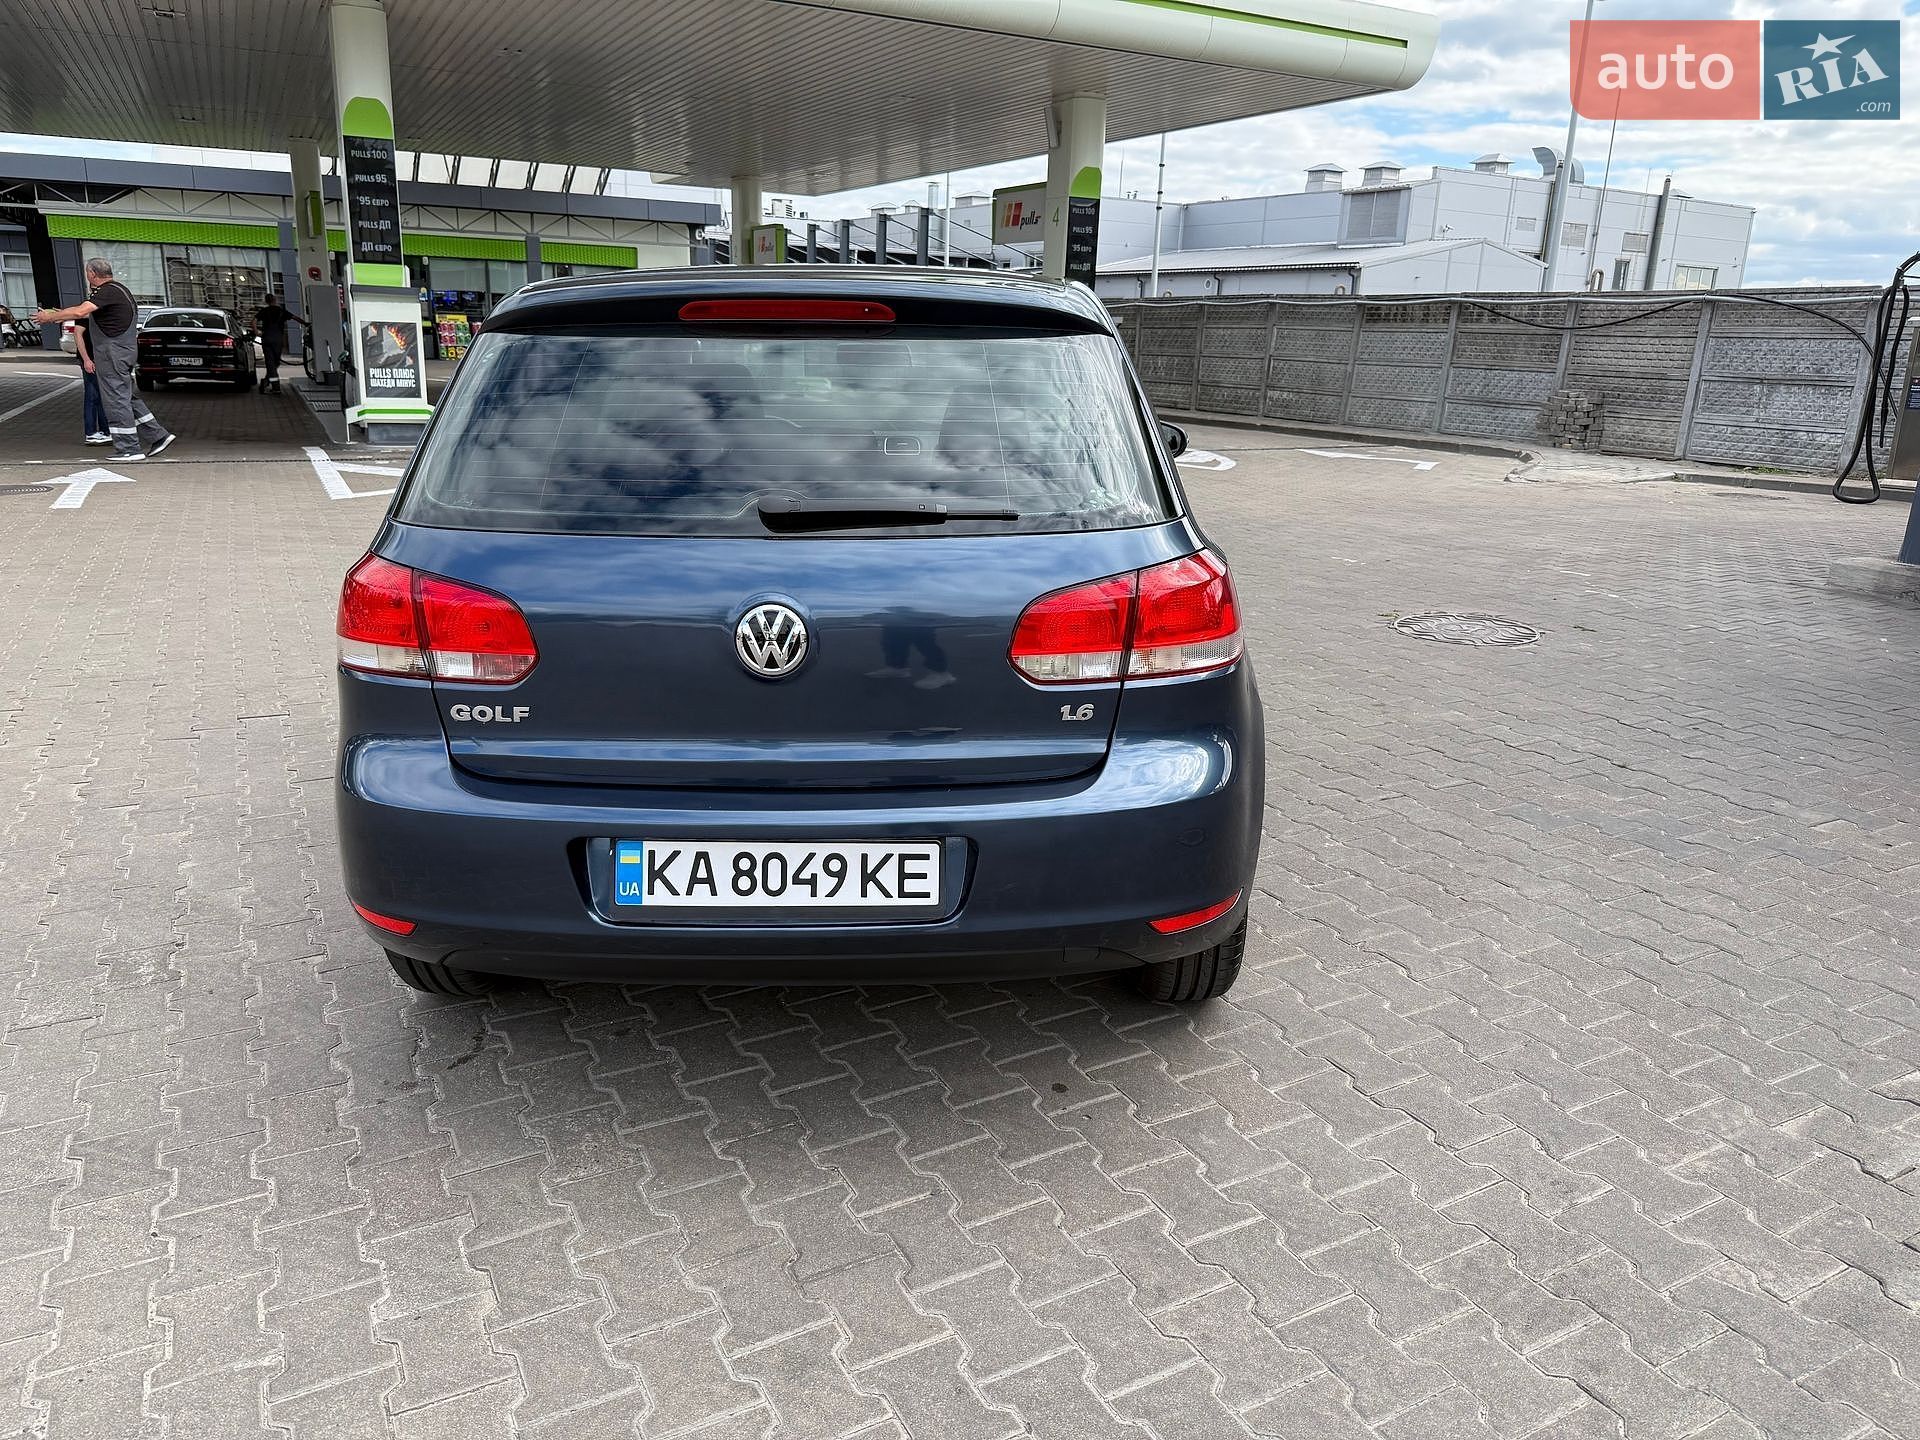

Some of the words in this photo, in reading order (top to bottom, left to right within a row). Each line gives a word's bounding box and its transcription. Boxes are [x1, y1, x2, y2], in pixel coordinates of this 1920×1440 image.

[350, 149, 370, 159] PULLS
[371, 149, 388, 160] 100
[355, 174, 375, 183] PULLS
[375, 173, 388, 183] 95
[358, 220, 379, 229] PULLS
[1020, 210, 1041, 230] pulls
[1053, 206, 1060, 227] 4
[369, 367, 392, 379] PULLS
[450, 704, 530, 723] GOLF
[1060, 703, 1095, 721] 1.6
[647, 849, 718, 897] KA
[731, 851, 849, 898] 8049
[860, 852, 931, 899] KE
[619, 881, 640, 897] UA
